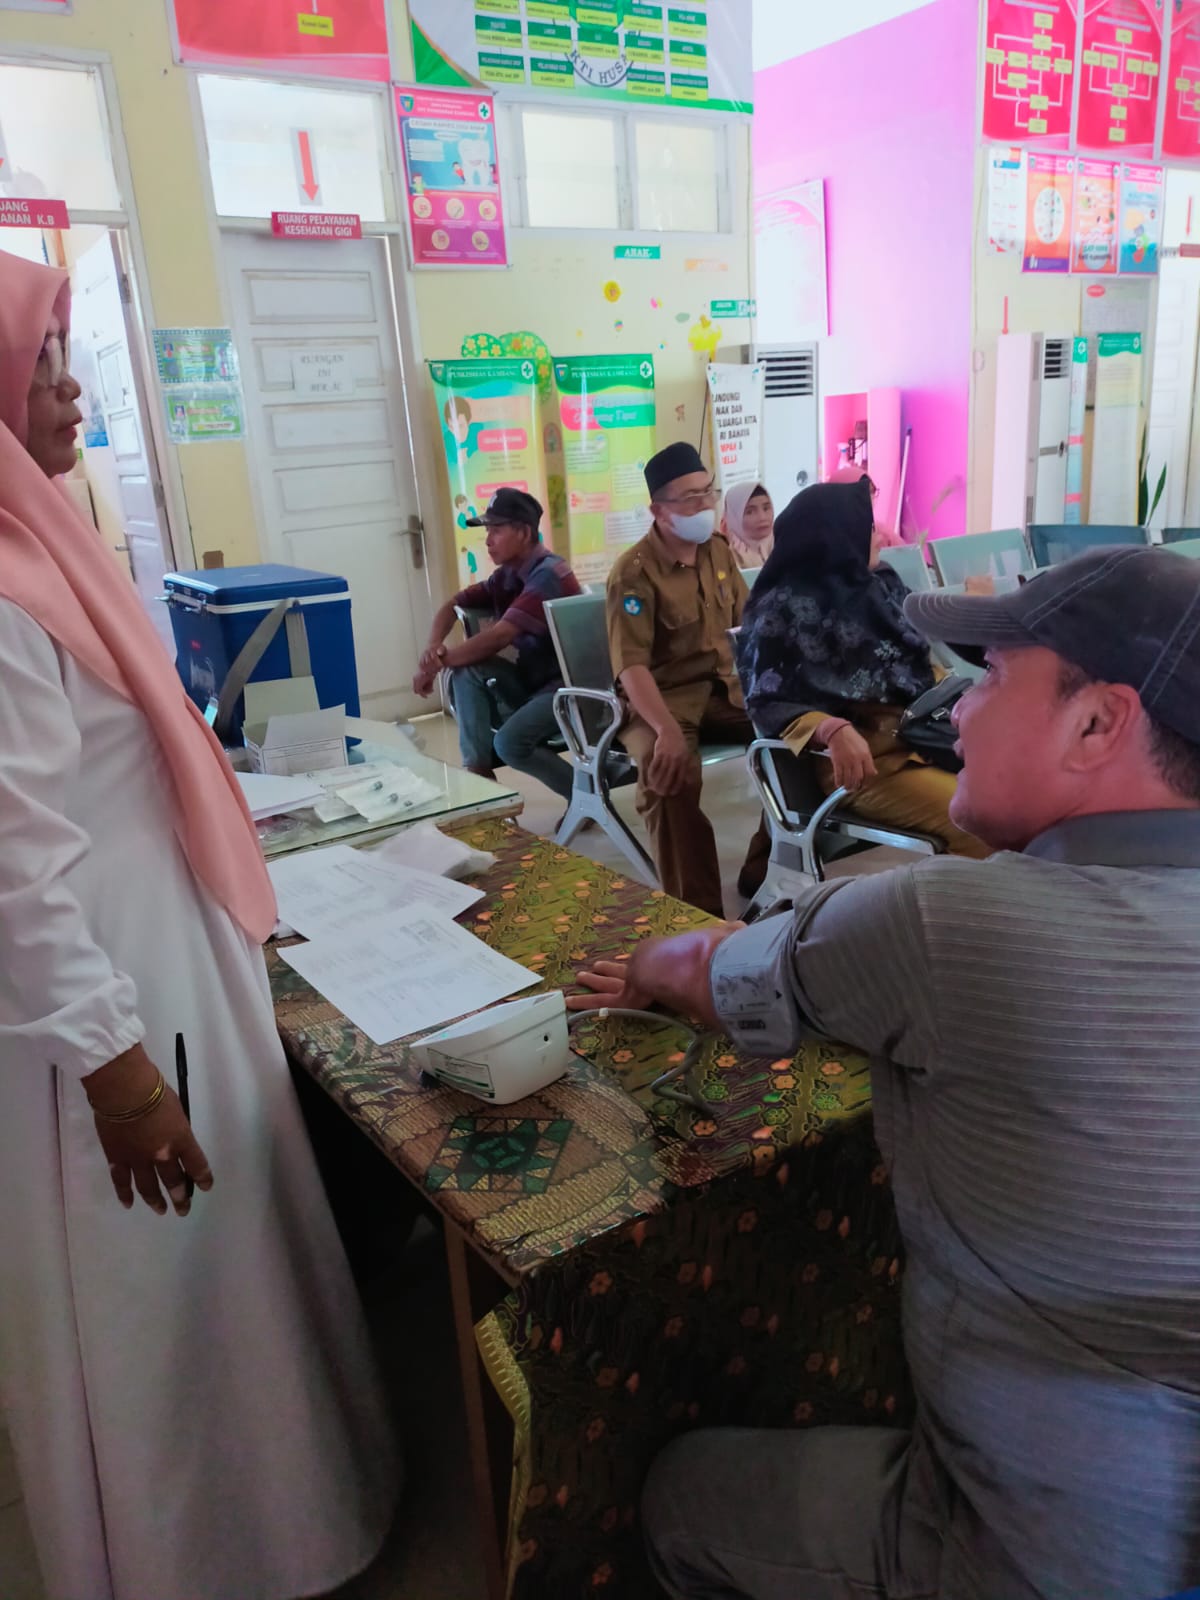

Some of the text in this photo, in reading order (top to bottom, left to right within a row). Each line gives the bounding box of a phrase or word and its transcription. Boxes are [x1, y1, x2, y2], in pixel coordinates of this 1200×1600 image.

[0, 201, 29, 212] UANG
[0, 213, 31, 225] ANAN
[277, 213, 357, 226] RUANG PELAYANAN
[284, 225, 352, 237] KESEHATAN GIGI
[715, 404, 729, 415] NAK
[717, 417, 742, 428] LUARGA
[720, 443, 736, 453] MPAK
